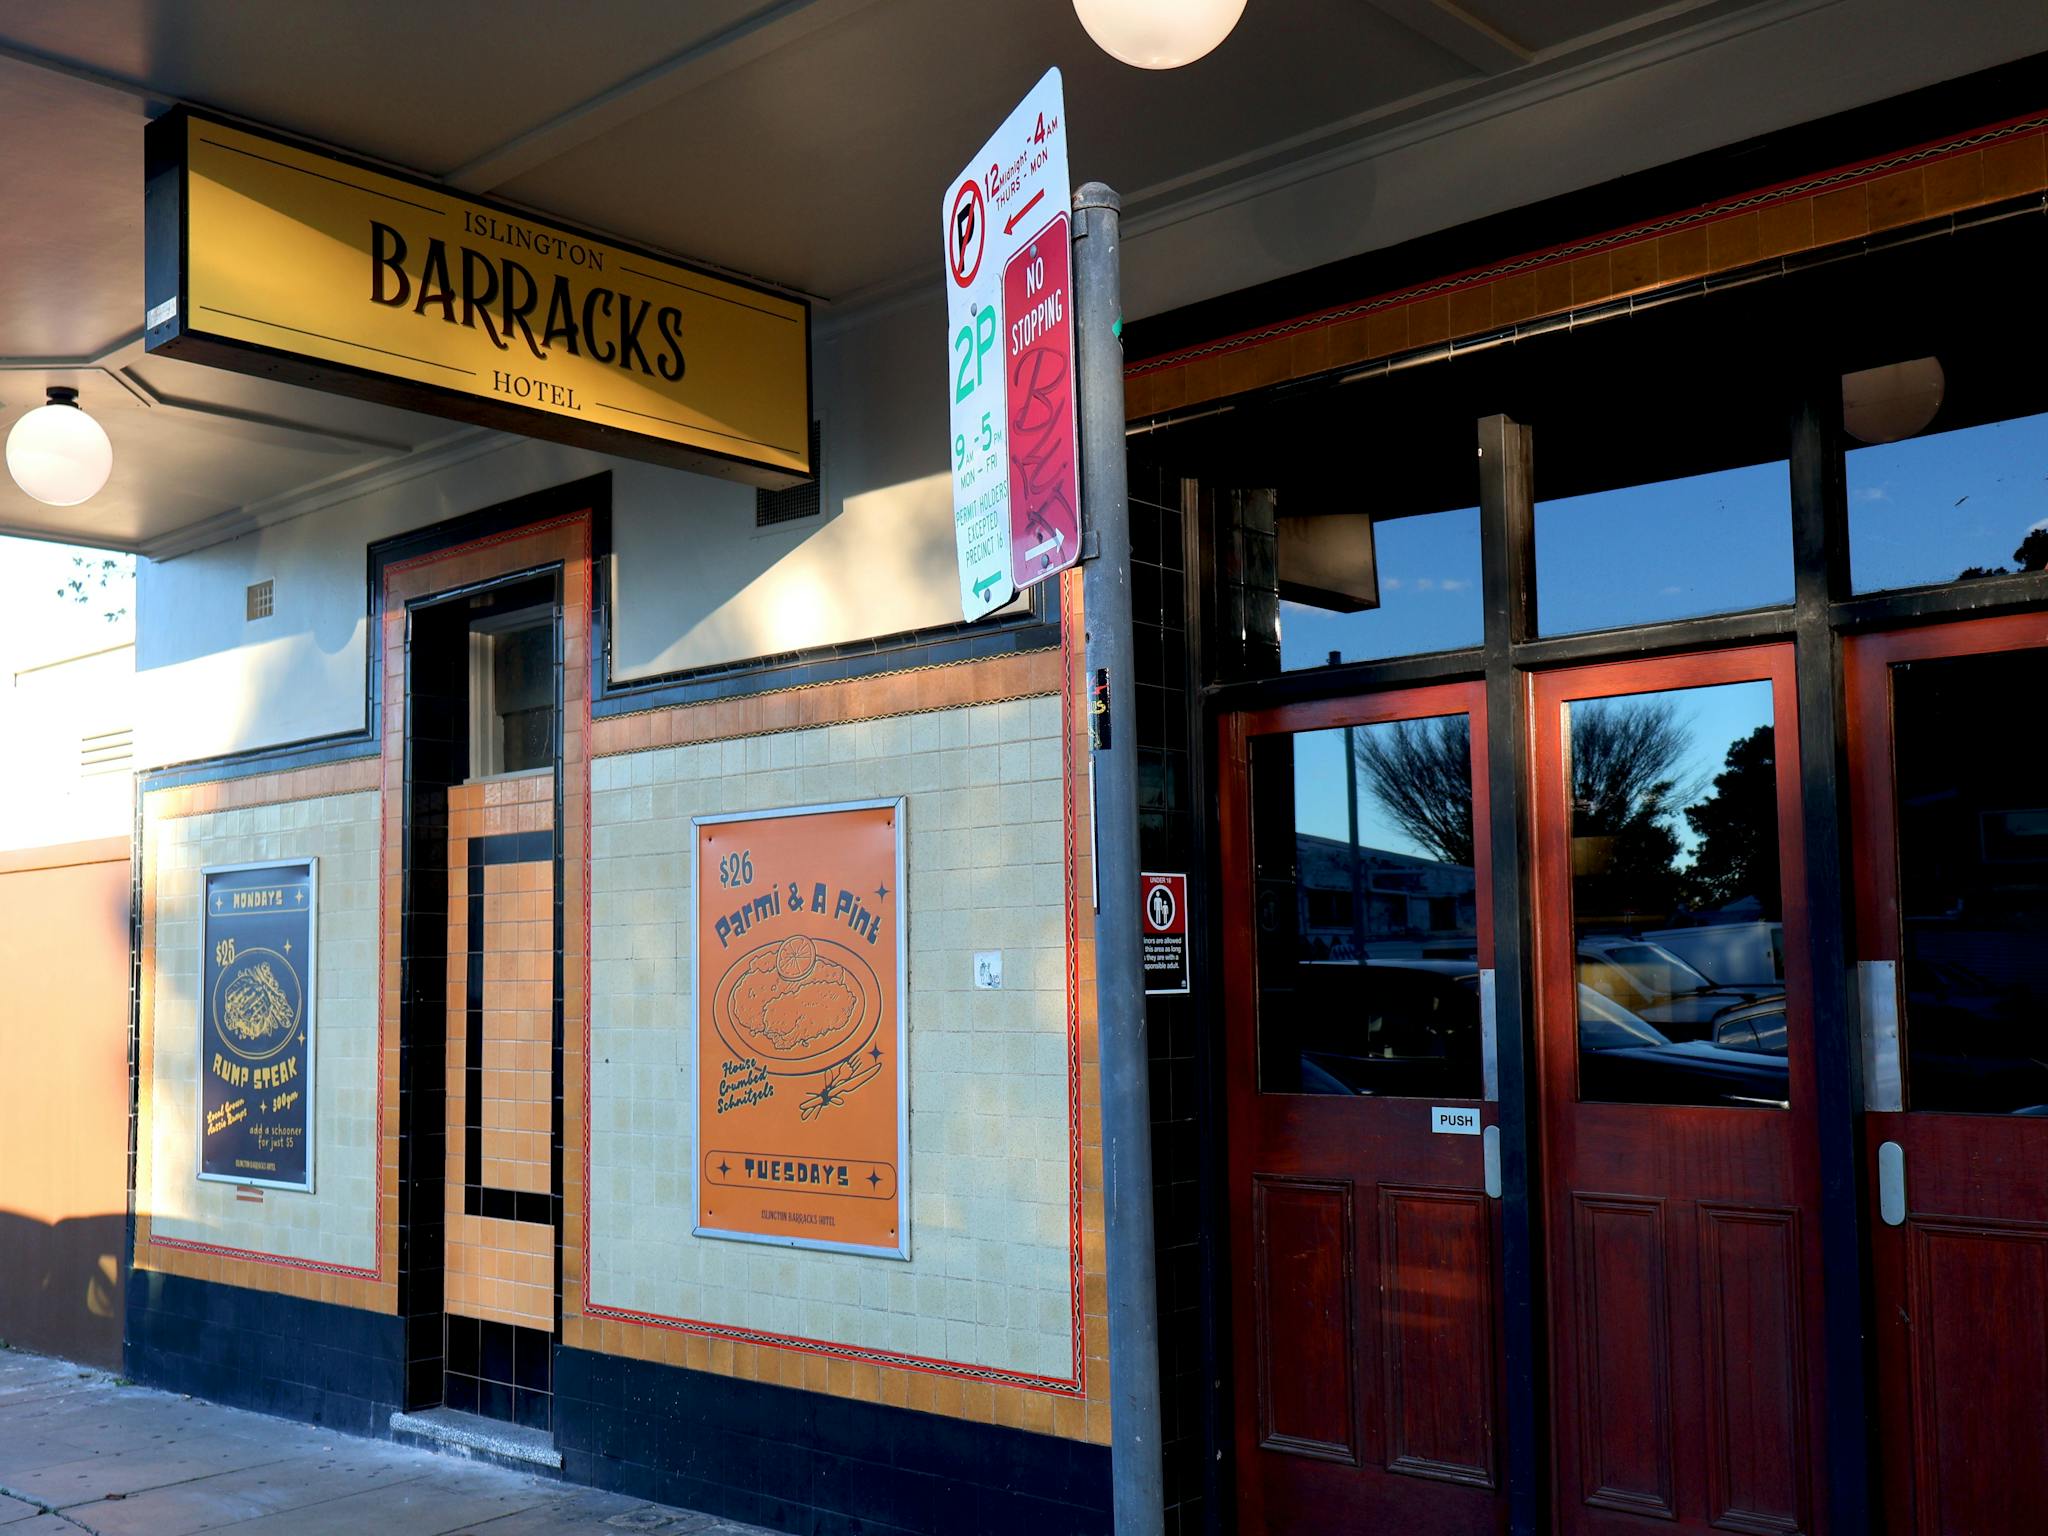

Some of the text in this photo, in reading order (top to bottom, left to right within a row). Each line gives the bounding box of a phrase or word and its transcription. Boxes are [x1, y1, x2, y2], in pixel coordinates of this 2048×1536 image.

[996, 176, 1021, 211] THURS
[1031, 147, 1048, 176] MON
[464, 211, 604, 272] ISLINGTON
[1026, 256, 1044, 299] NO
[369, 219, 686, 382] BARRACKS
[1012, 288, 1062, 356] STOPPING
[954, 304, 996, 405] 2P
[493, 370, 581, 411] HOTEL
[960, 467, 976, 492] MON
[986, 452, 998, 472] FRI
[956, 480, 1008, 528] PERMIT HOLDERS
[968, 510, 997, 544] EXCEPTED
[966, 536, 994, 568] PRECINCT
[719, 849, 754, 889] $26
[233, 890, 283, 909] MONDAYS
[714, 882, 882, 949] Parmi & A Pint
[215, 938, 235, 967] $25
[1143, 936, 1156, 944] inors
[1164, 936, 1182, 944] allowed
[1171, 945, 1182, 953] long
[212, 1052, 298, 1089] RUMP STEAK
[719, 1064, 768, 1097] Crumbed
[722, 1058, 757, 1078] House
[717, 1081, 775, 1114] Schnitzels
[249, 1123, 262, 1135] add
[271, 1123, 302, 1136] schooner
[1440, 1114, 1473, 1127] PUSH
[258, 1135, 294, 1152] for just $5
[744, 1158, 849, 1187] TUESDAYS
